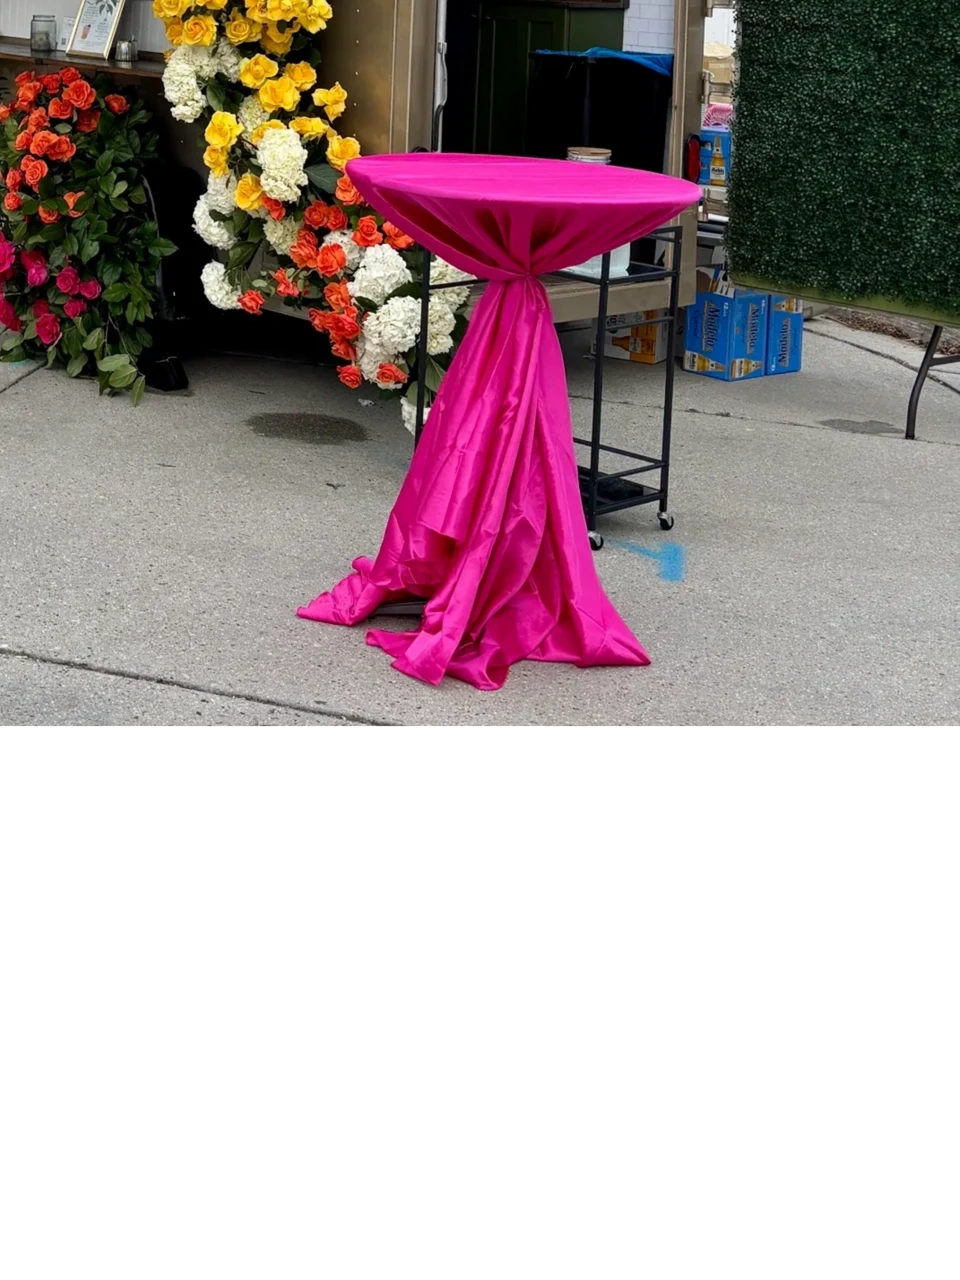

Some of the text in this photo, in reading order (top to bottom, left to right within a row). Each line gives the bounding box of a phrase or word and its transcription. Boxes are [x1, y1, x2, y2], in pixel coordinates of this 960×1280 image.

[706, 307, 721, 347] Modelo
[748, 308, 760, 348] Modelo
[777, 323, 788, 363] Modelo
